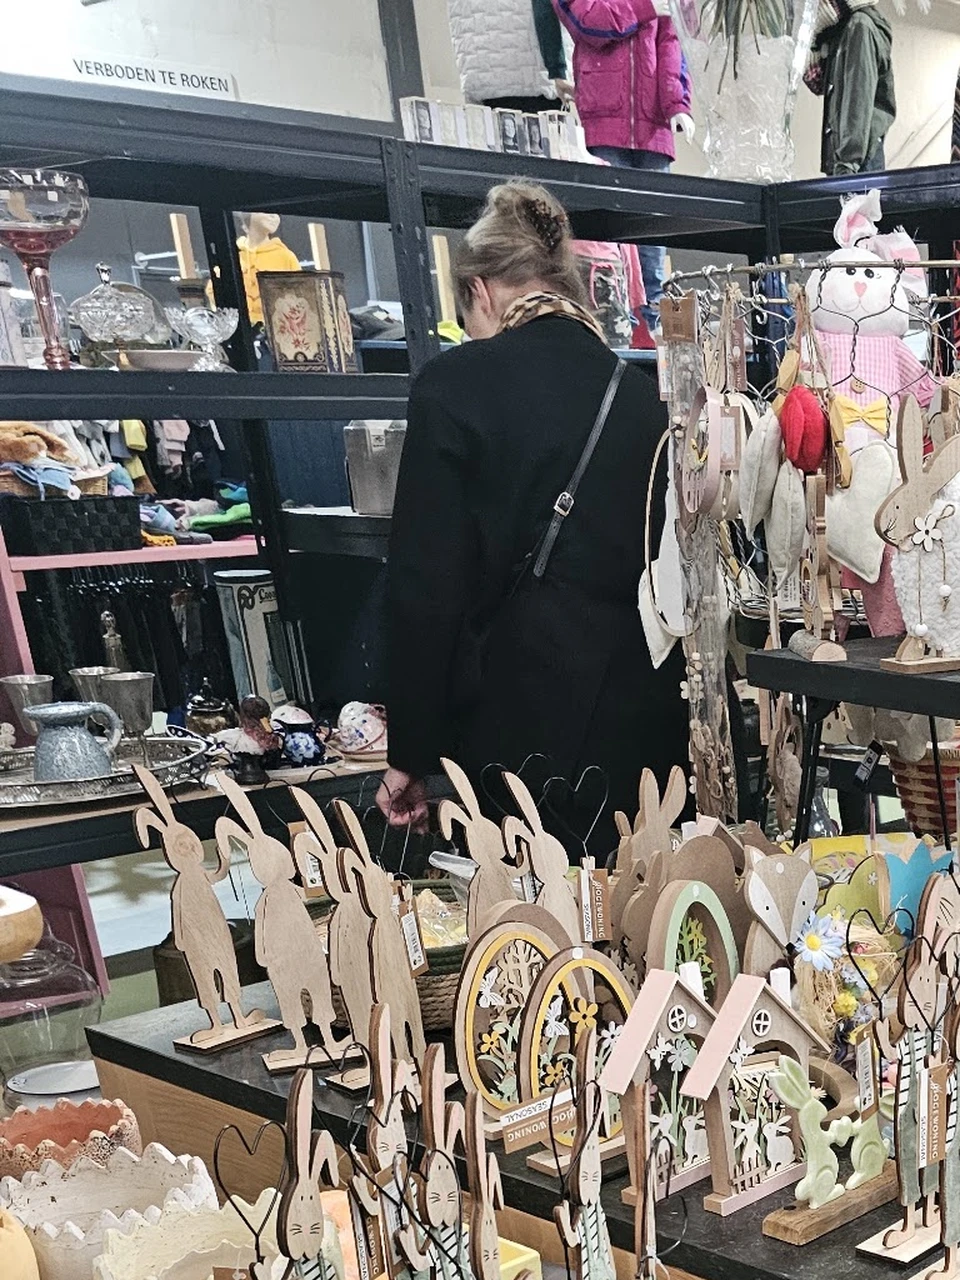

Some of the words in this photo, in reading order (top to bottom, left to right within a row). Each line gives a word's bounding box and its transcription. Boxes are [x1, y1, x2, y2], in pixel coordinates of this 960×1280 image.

[72, 58, 156, 83] VERBODEN
[158, 69, 177, 86] TE
[180, 73, 229, 92] ROKEN
[504, 1100, 548, 1123] SEASONAL
